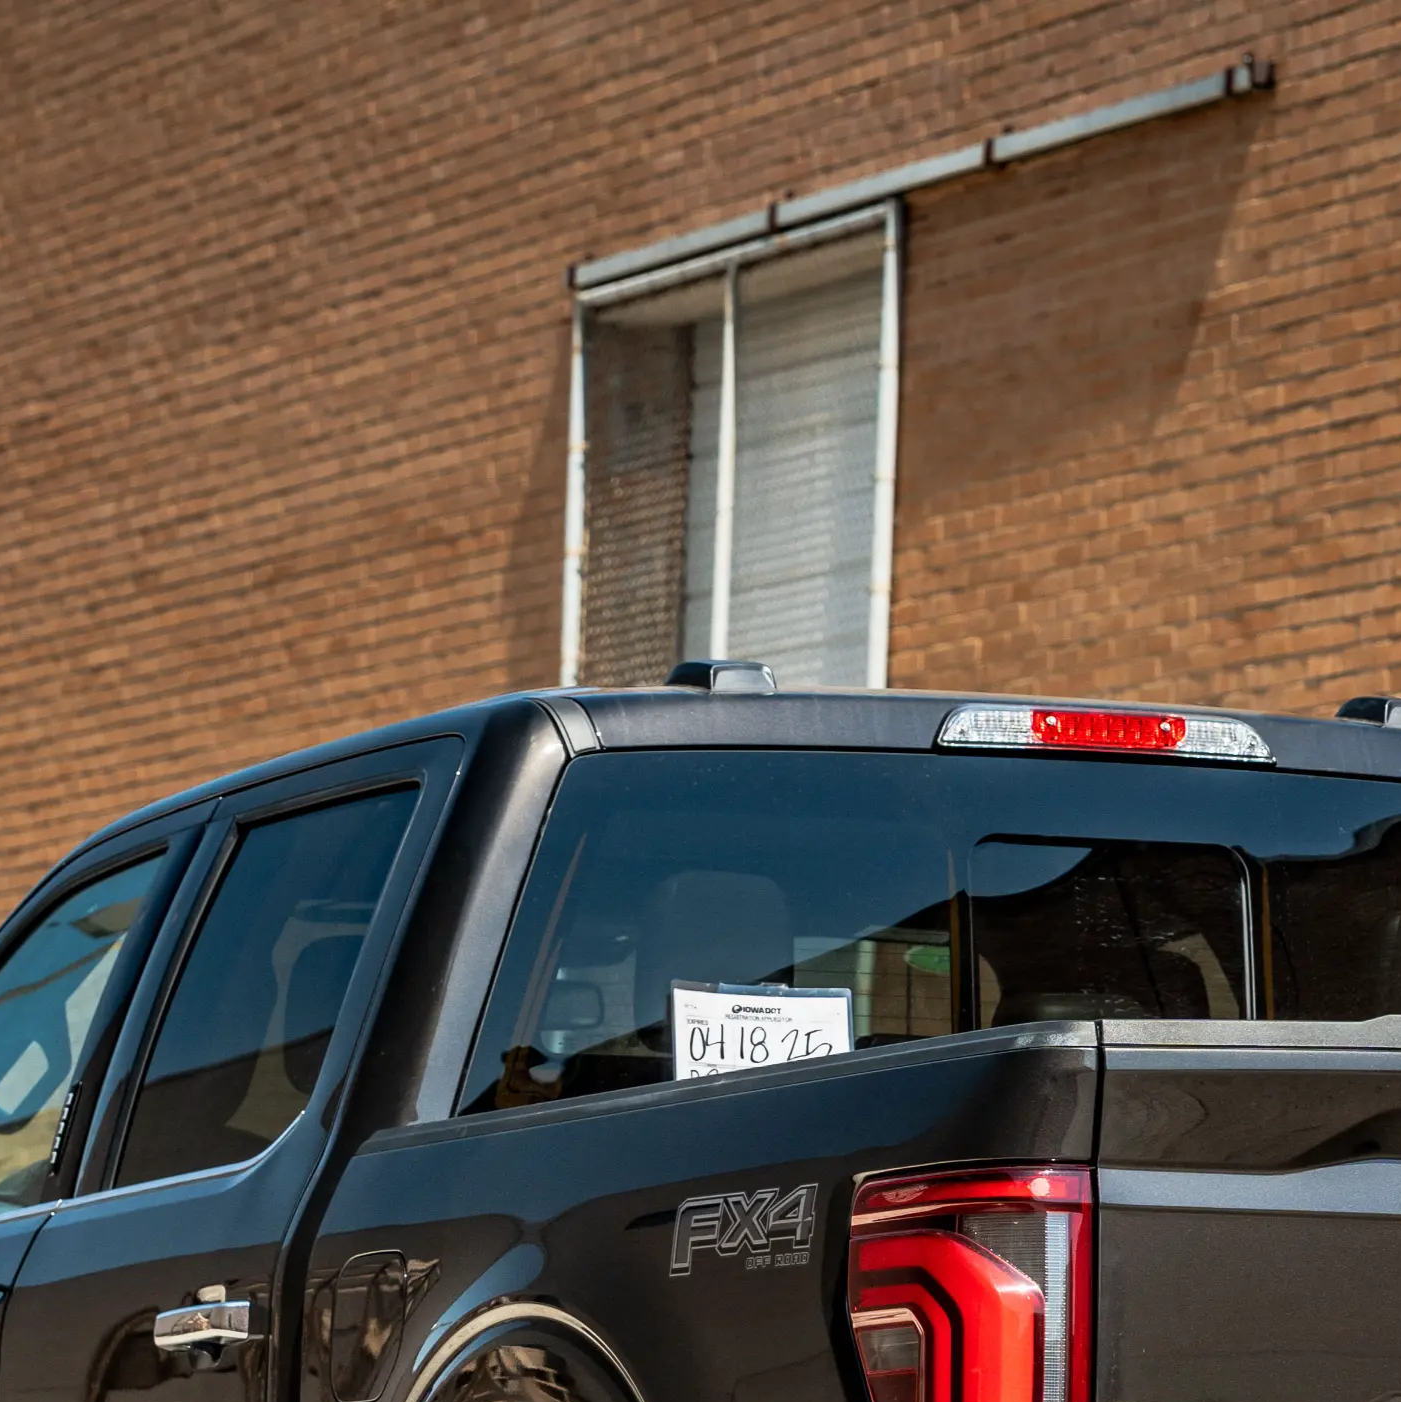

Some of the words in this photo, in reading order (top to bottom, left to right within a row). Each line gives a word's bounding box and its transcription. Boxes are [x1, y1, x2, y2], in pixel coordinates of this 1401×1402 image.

[742, 1006, 765, 1014] IOWA
[765, 1007, 782, 1015] DOT
[689, 1024, 725, 1061] 04
[740, 1026, 769, 1063] 18
[781, 1029, 833, 1061] 25
[669, 1183, 819, 1277] FX4
[745, 1255, 772, 1270] OFF
[774, 1252, 810, 1267] ROAD
